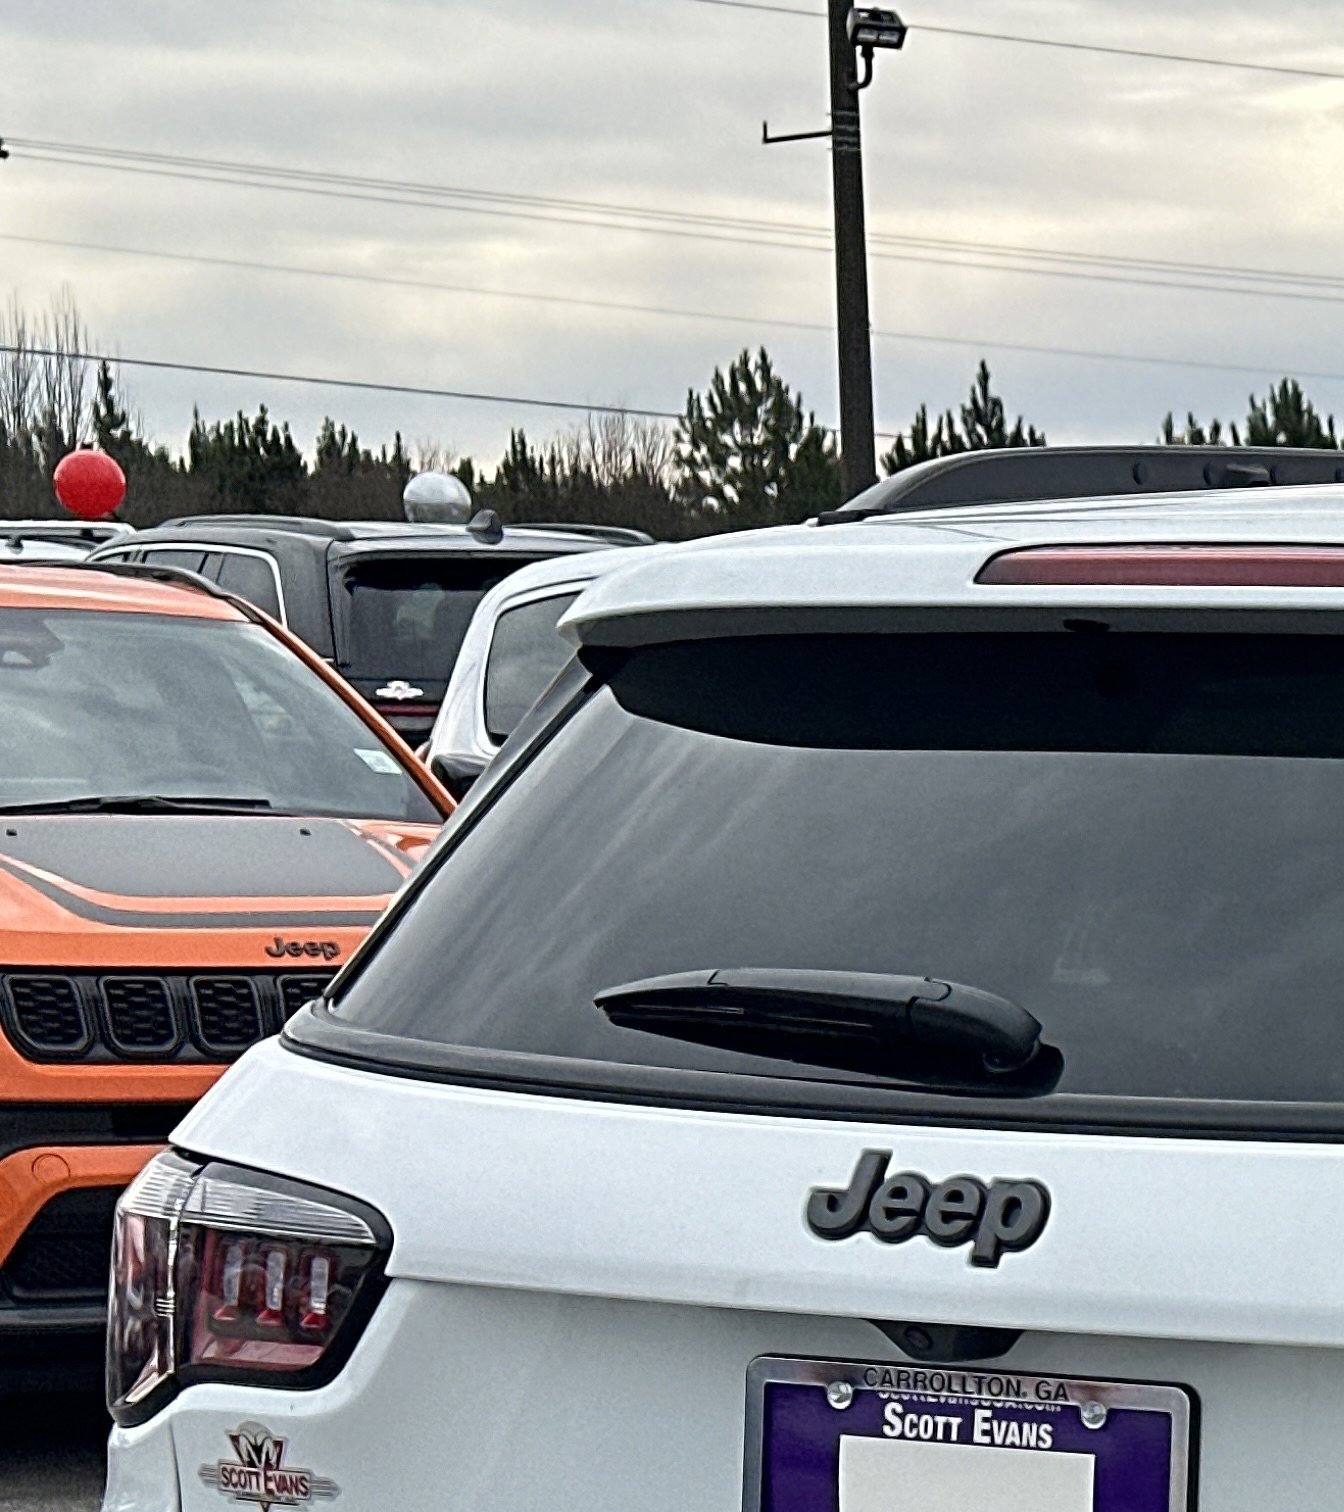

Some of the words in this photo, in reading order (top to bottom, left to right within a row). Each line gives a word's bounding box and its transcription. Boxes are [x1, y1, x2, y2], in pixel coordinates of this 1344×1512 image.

[265, 937, 340, 961] Jeep
[806, 1148, 1052, 1268] Jeep
[1035, 1380, 1069, 1402] GA
[221, 1466, 261, 1491] SCOTT
[264, 1469, 309, 1497] EVANS
